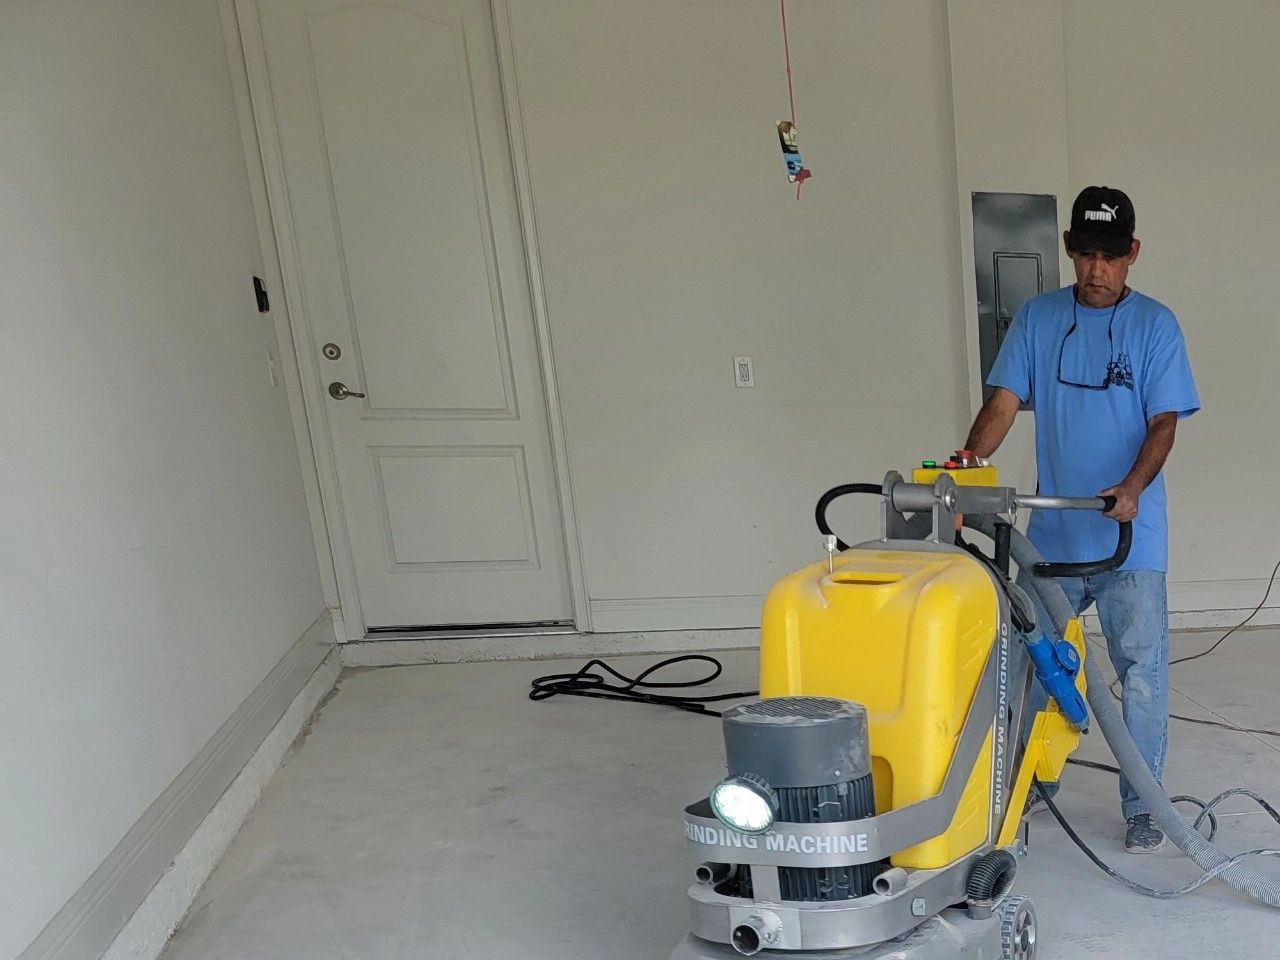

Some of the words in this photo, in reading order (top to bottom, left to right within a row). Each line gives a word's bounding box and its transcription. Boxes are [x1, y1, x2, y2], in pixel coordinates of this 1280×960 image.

[1085, 210, 1112, 222] PUMA
[998, 622, 1008, 719] GRINDING
[994, 726, 1006, 816] MACHINE
[765, 833, 869, 854] MACHINE
